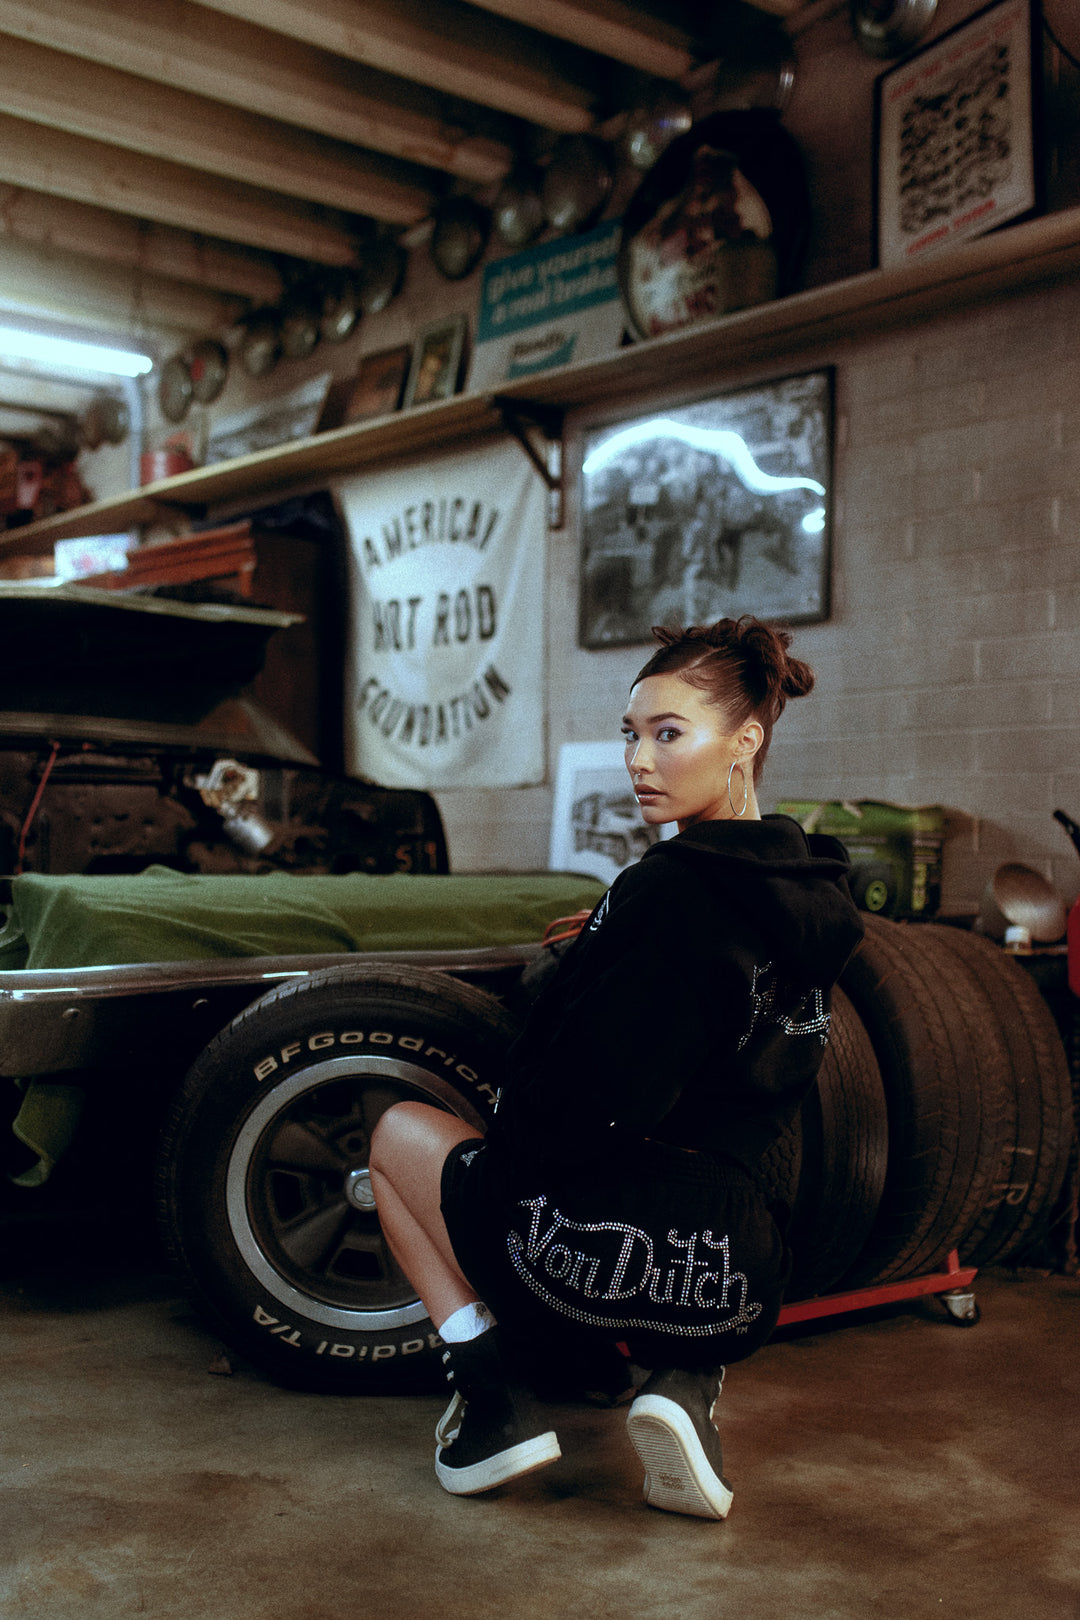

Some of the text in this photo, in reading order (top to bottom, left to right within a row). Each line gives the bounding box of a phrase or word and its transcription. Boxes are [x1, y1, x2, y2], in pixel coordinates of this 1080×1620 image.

[372, 584, 496, 652] HOT ROD
[358, 664, 512, 747] FOUNDATION
[517, 1194, 749, 1318] Von Dutch
[253, 1304, 302, 1347] T/A
